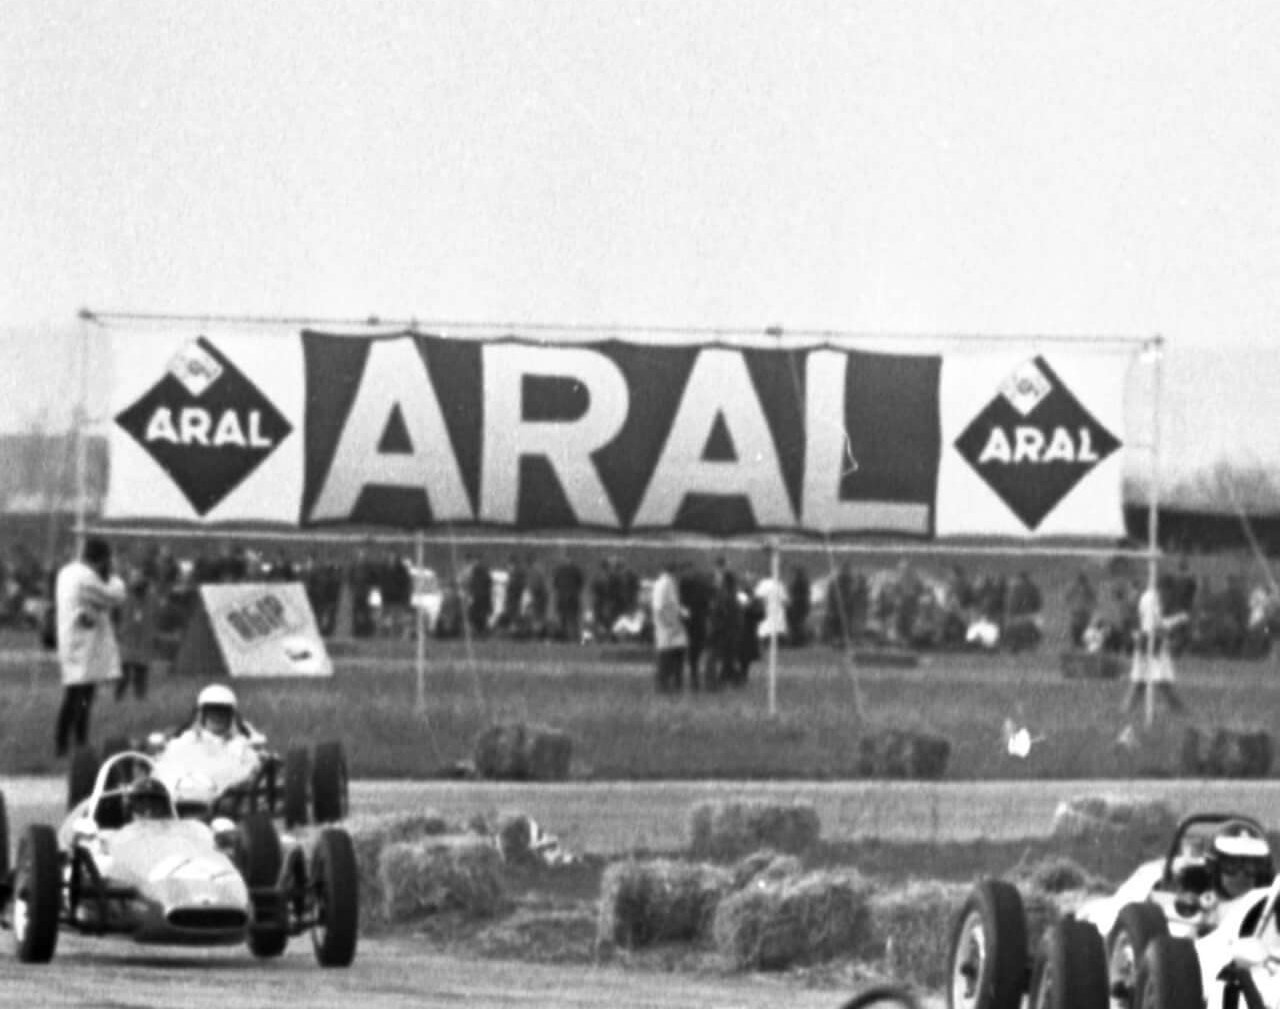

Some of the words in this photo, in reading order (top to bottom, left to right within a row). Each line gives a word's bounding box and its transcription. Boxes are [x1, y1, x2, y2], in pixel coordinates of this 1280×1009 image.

[145, 406, 273, 448] ARAL
[308, 335, 930, 534] ARAL
[976, 425, 1100, 465] ARAL
